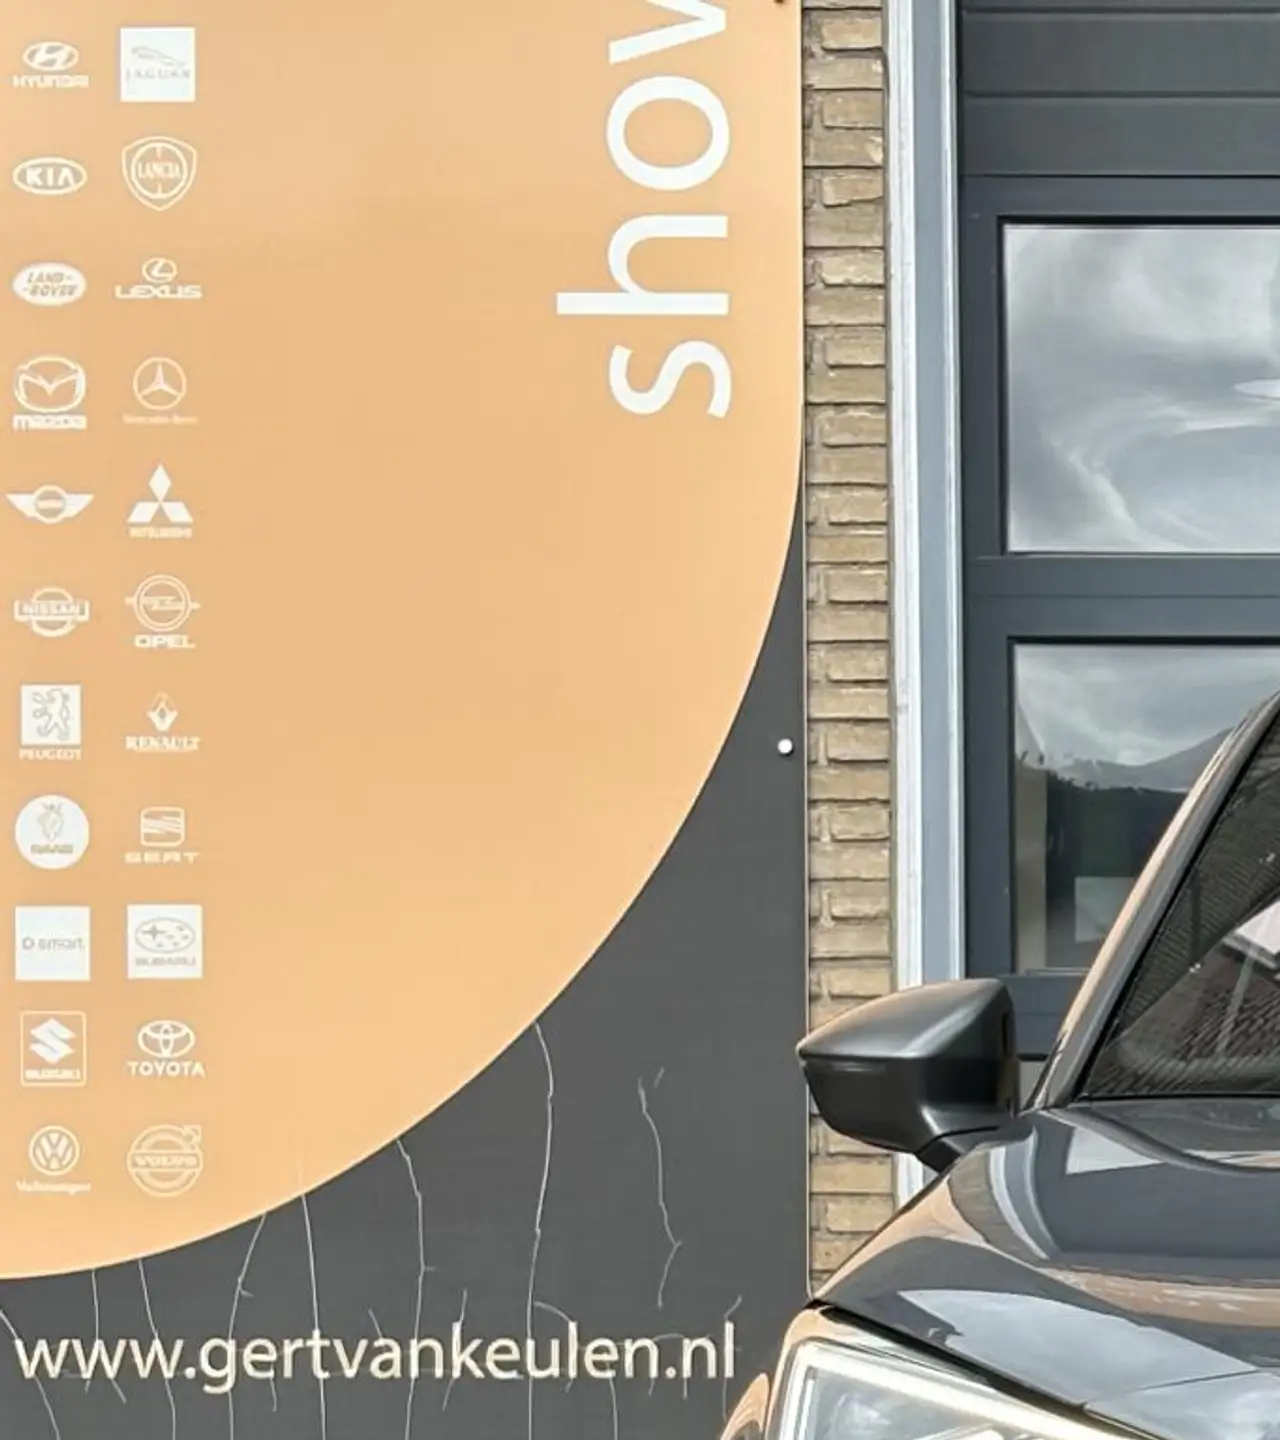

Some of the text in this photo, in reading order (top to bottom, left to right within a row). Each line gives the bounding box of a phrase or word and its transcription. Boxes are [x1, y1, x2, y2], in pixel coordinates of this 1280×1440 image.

[25, 167, 75, 187] KIA
[115, 285, 203, 299] LEXUS
[134, 635, 196, 648] OPEL
[124, 852, 200, 863] SEAT
[127, 1061, 206, 1079] TOYOTA
[14, 1321, 735, 1394] www.gertvankeulen.nl
